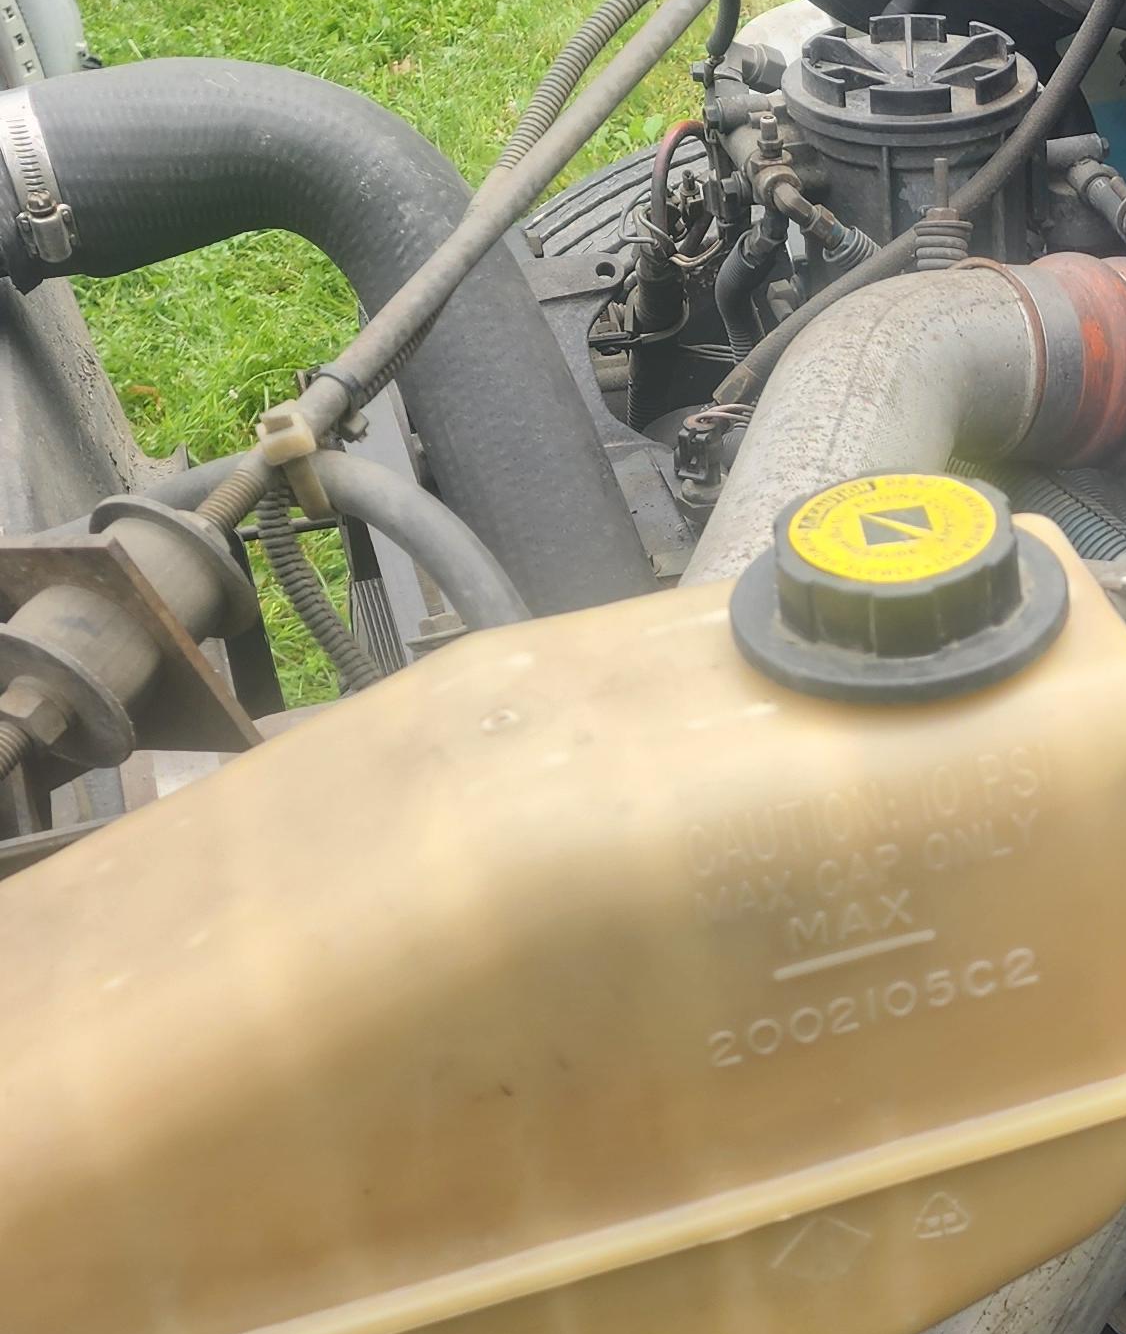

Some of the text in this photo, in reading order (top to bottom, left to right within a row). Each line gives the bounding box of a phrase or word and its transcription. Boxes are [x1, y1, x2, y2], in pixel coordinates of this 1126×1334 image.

[815, 842, 903, 898] CAP
[922, 807, 1040, 872] ONLY
[787, 889, 913, 951] MAX
[706, 946, 1041, 1069] 2002105C2
